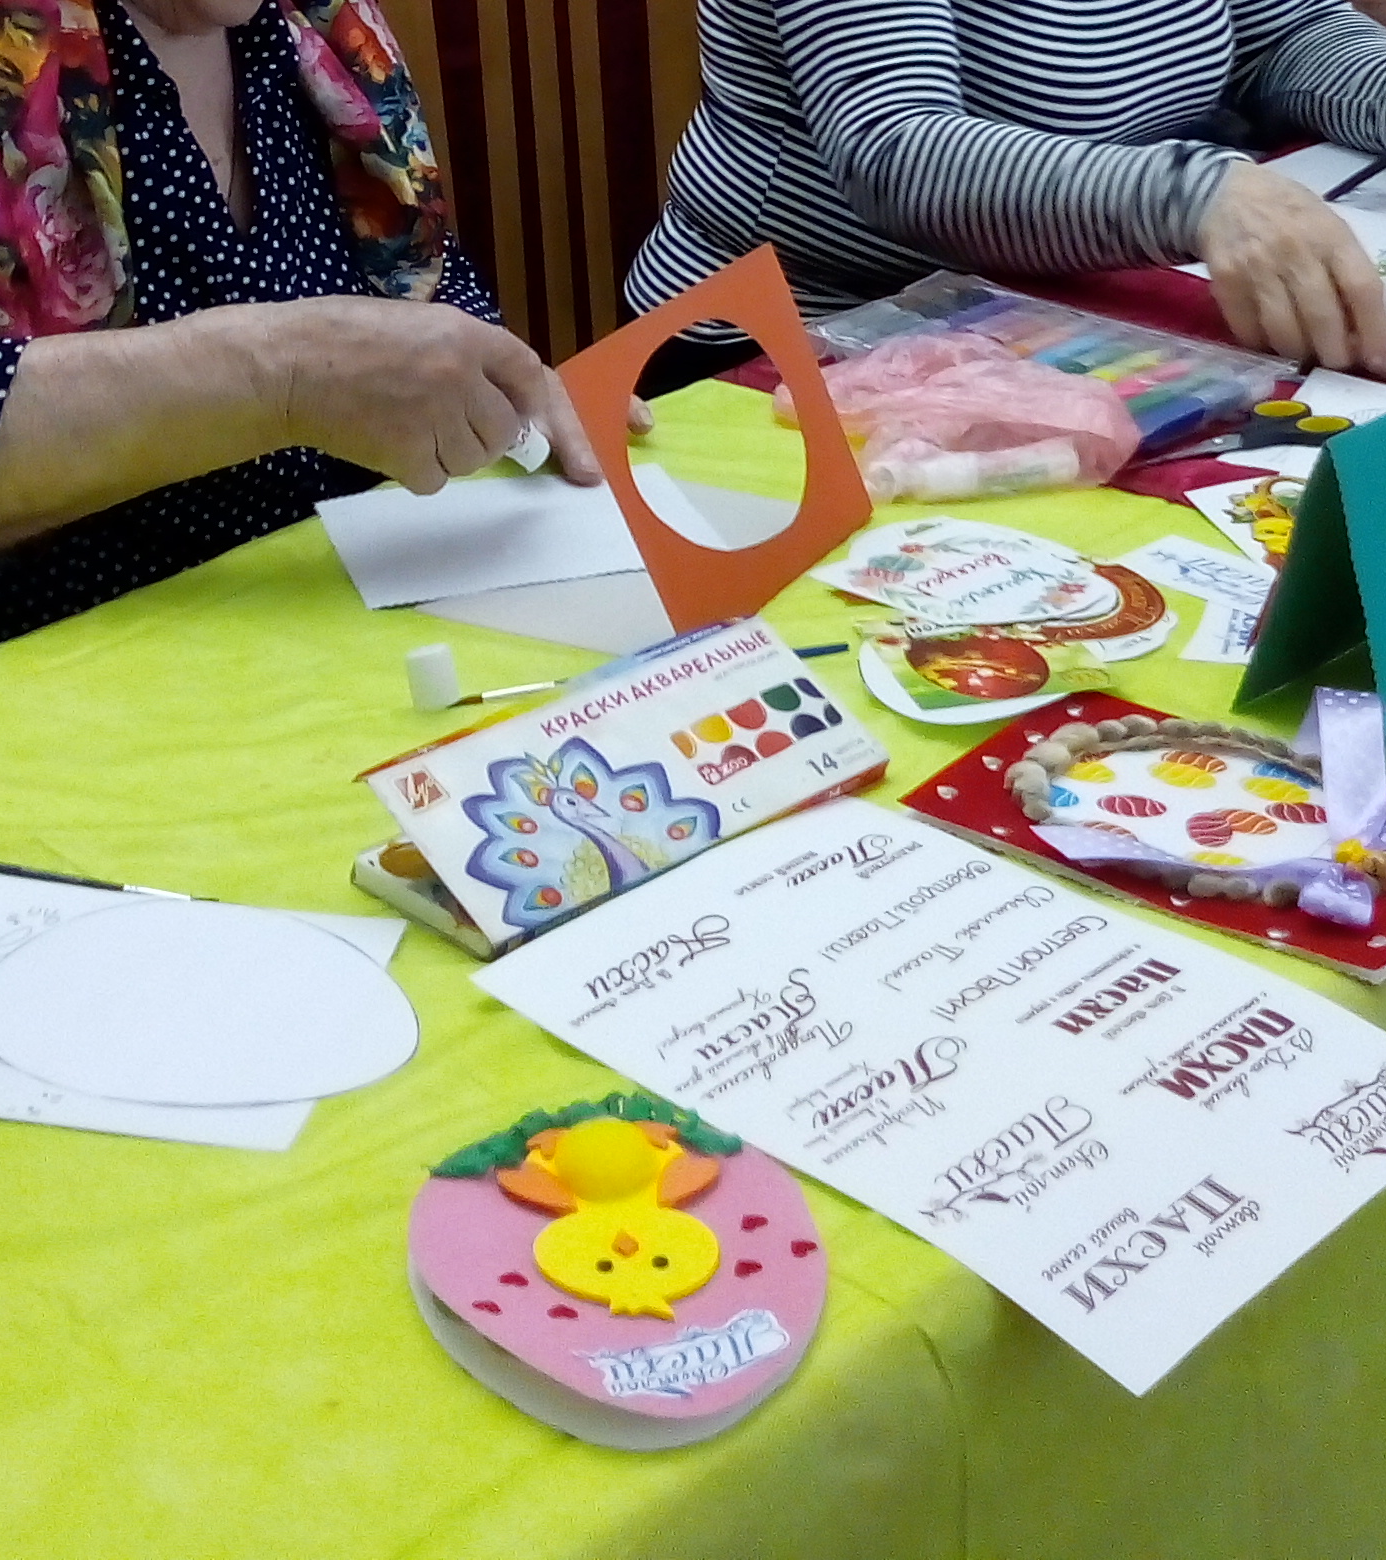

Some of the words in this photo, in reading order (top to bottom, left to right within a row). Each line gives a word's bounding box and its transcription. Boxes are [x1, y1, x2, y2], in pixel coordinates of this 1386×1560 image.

[539, 691, 629, 739] КРАСКИ
[630, 628, 772, 703] АКВАРЕЛЬНЫЕ
[806, 746, 840, 778] 14
[785, 833, 892, 887] Пасхи
[1006, 914, 1108, 972] Светлой
[671, 967, 816, 1067] Пасхи
[930, 967, 1021, 1023] Пасхи!
[1052, 958, 1180, 1034] Пасхи
[1156, 1007, 1294, 1099] ПАСХИ
[1062, 1175, 1243, 1311] ПАСХИ
[1086, 1207, 1140, 1248] вашей
[1192, 1199, 1260, 1257] светлой
